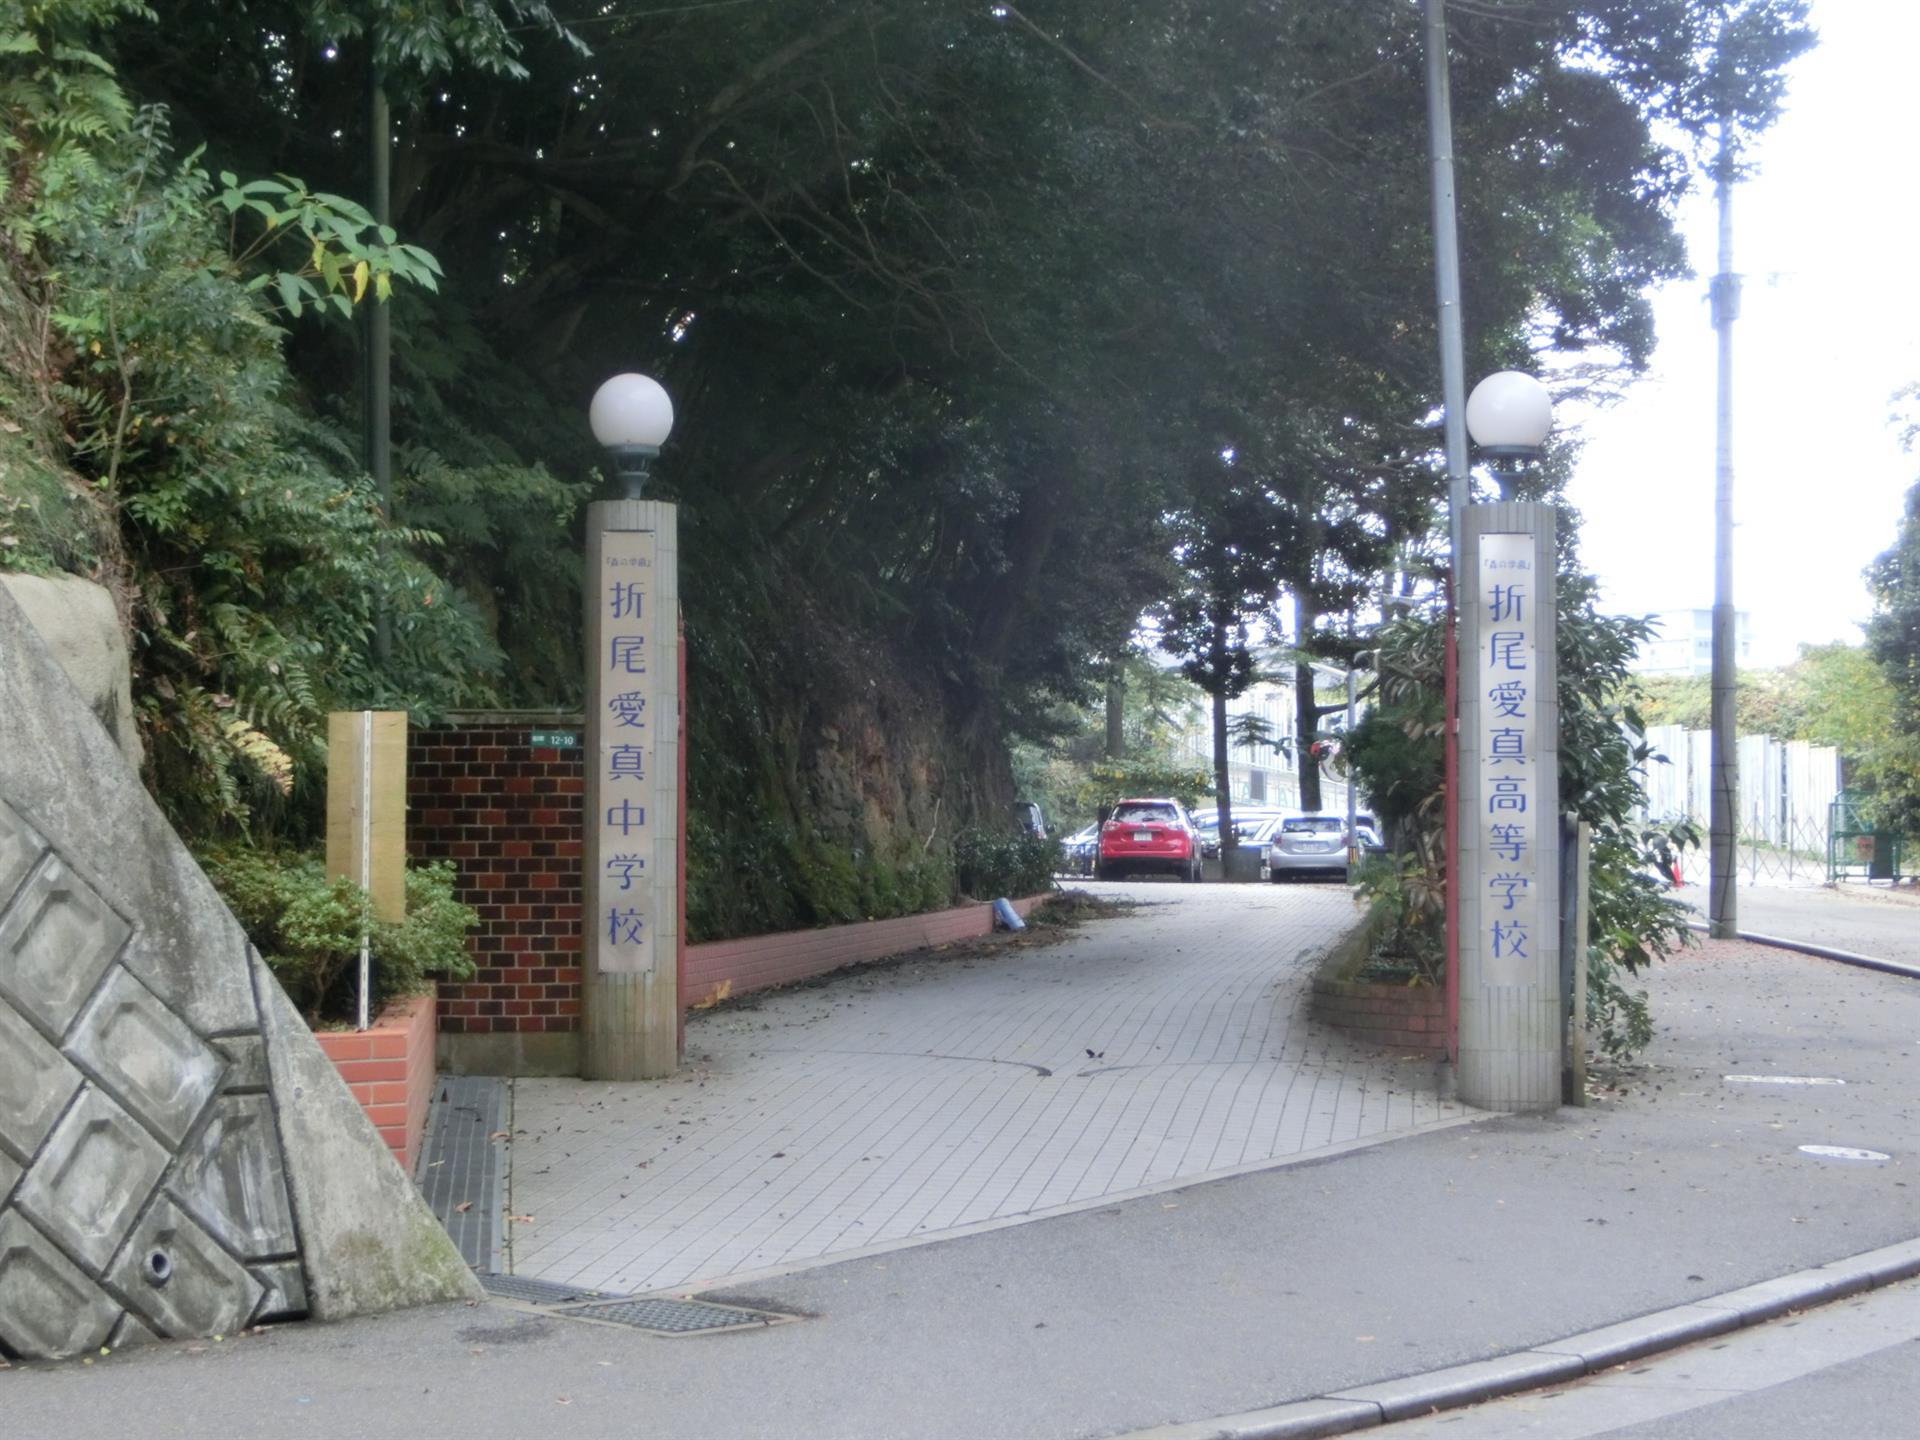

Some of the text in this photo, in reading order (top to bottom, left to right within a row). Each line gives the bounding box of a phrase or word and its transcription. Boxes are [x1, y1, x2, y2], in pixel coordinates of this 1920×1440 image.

[551, 735, 574, 745] 12-10
[607, 582, 647, 946] 折尾愛真中学校
[1488, 584, 1529, 959] 折尾愛真高等学校
